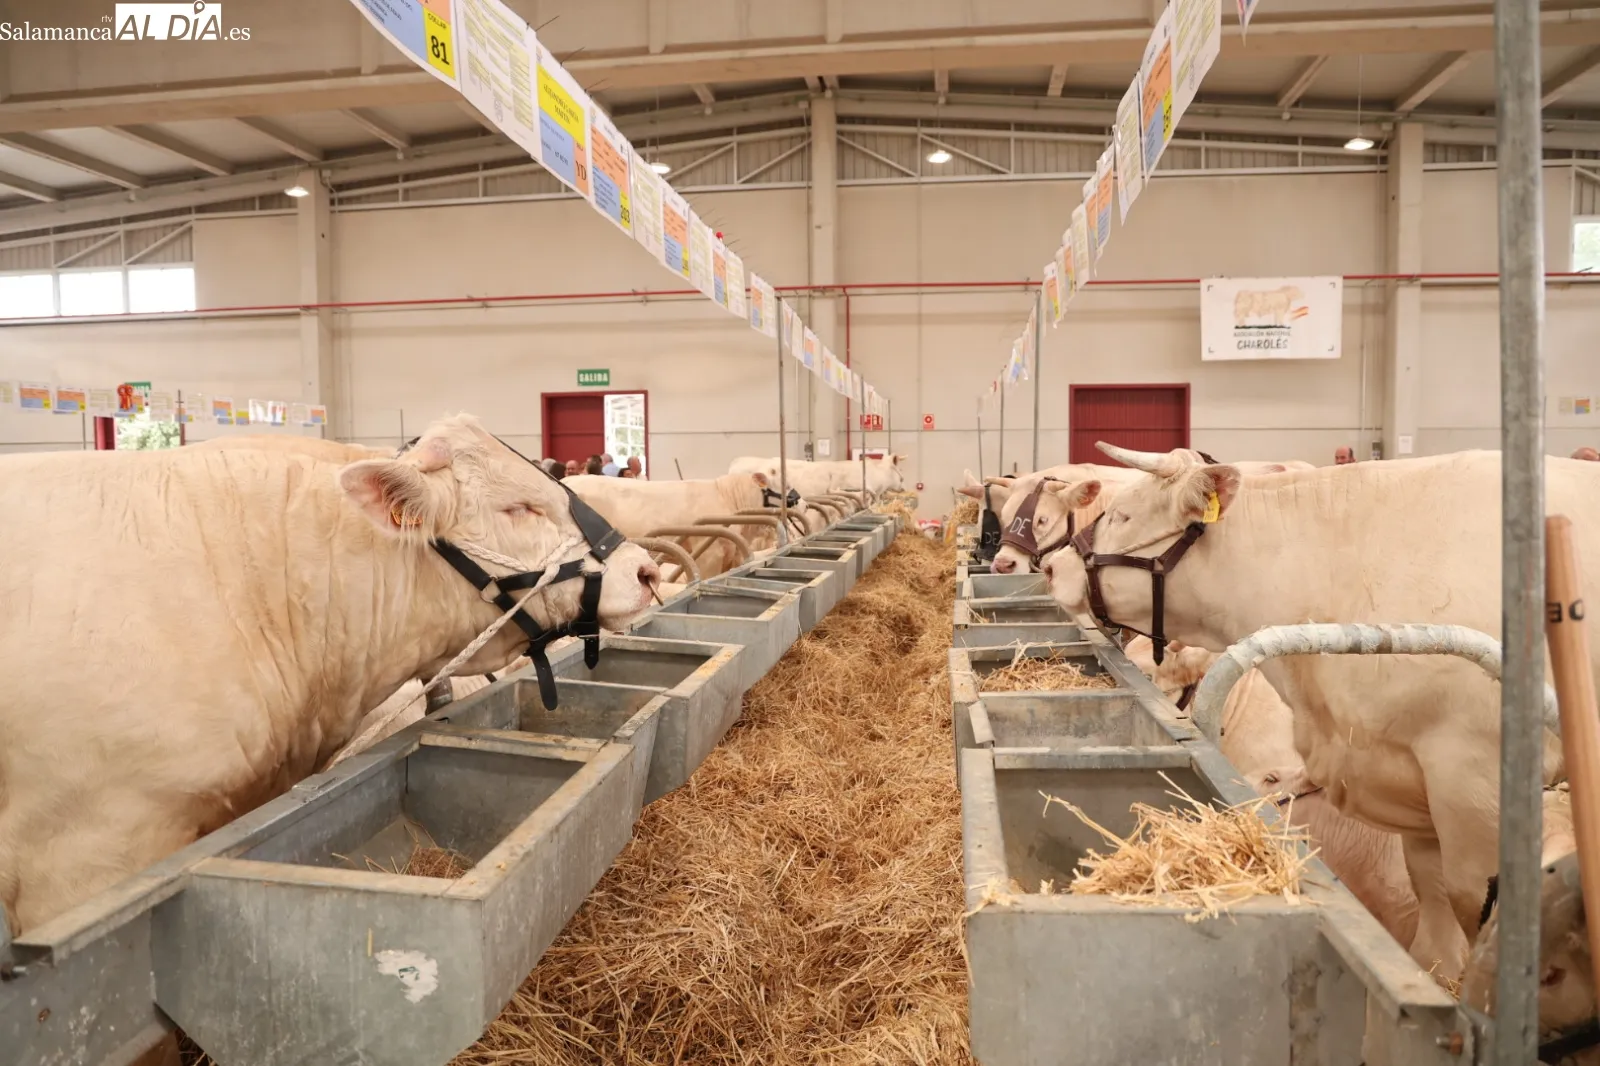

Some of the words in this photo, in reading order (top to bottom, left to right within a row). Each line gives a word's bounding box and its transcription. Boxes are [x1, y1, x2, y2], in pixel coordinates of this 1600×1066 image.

[430, 35, 450, 66] 81
[579, 373, 608, 382] SALIDA
[1009, 516, 1031, 538] DE
